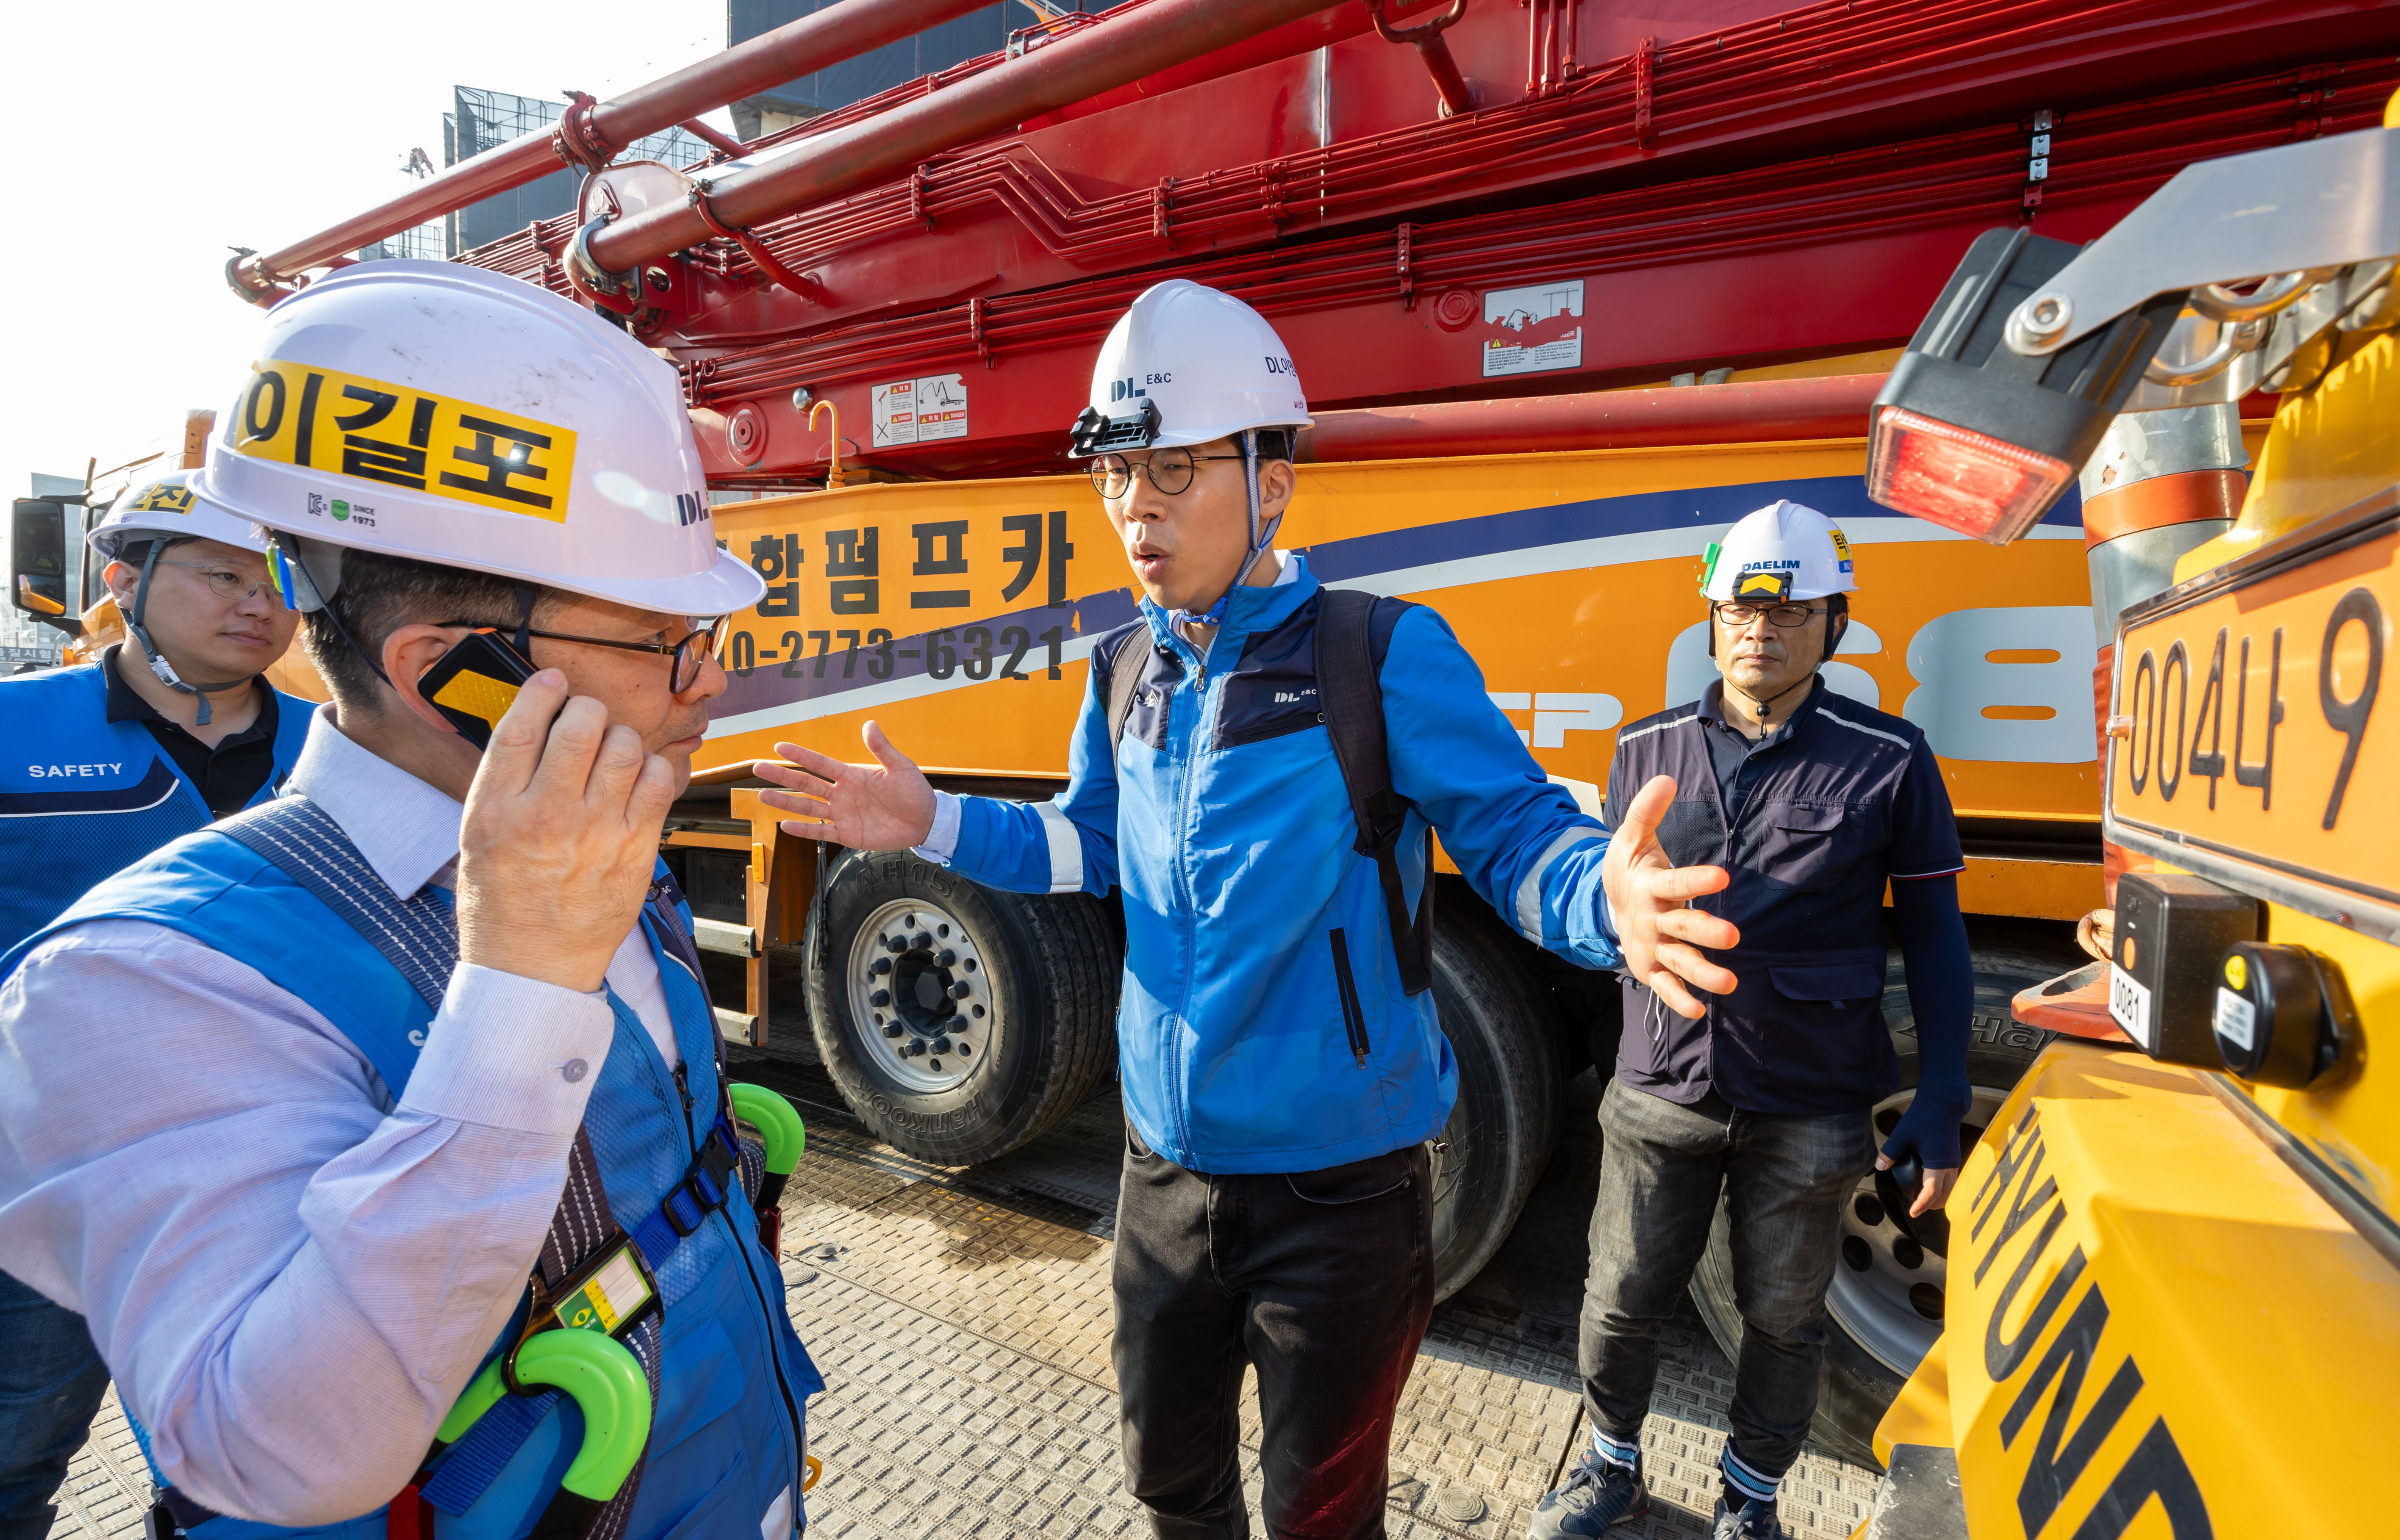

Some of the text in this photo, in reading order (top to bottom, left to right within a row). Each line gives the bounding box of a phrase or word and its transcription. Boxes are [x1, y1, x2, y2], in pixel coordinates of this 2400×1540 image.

[1111, 373, 1171, 402] DL E&C
[246, 371, 553, 510] 이길포
[352, 515, 375, 527] 1973
[353, 504, 375, 515] SINCE
[676, 490, 709, 526] DL
[716, 511, 1074, 620] 합펌프카
[1742, 560, 1800, 572] DAELIM
[1274, 692, 1300, 703] DL
[2130, 587, 2384, 831] 004나 9
[29, 763, 122, 778] SAFETY
[2115, 977, 2139, 1027] 0081
